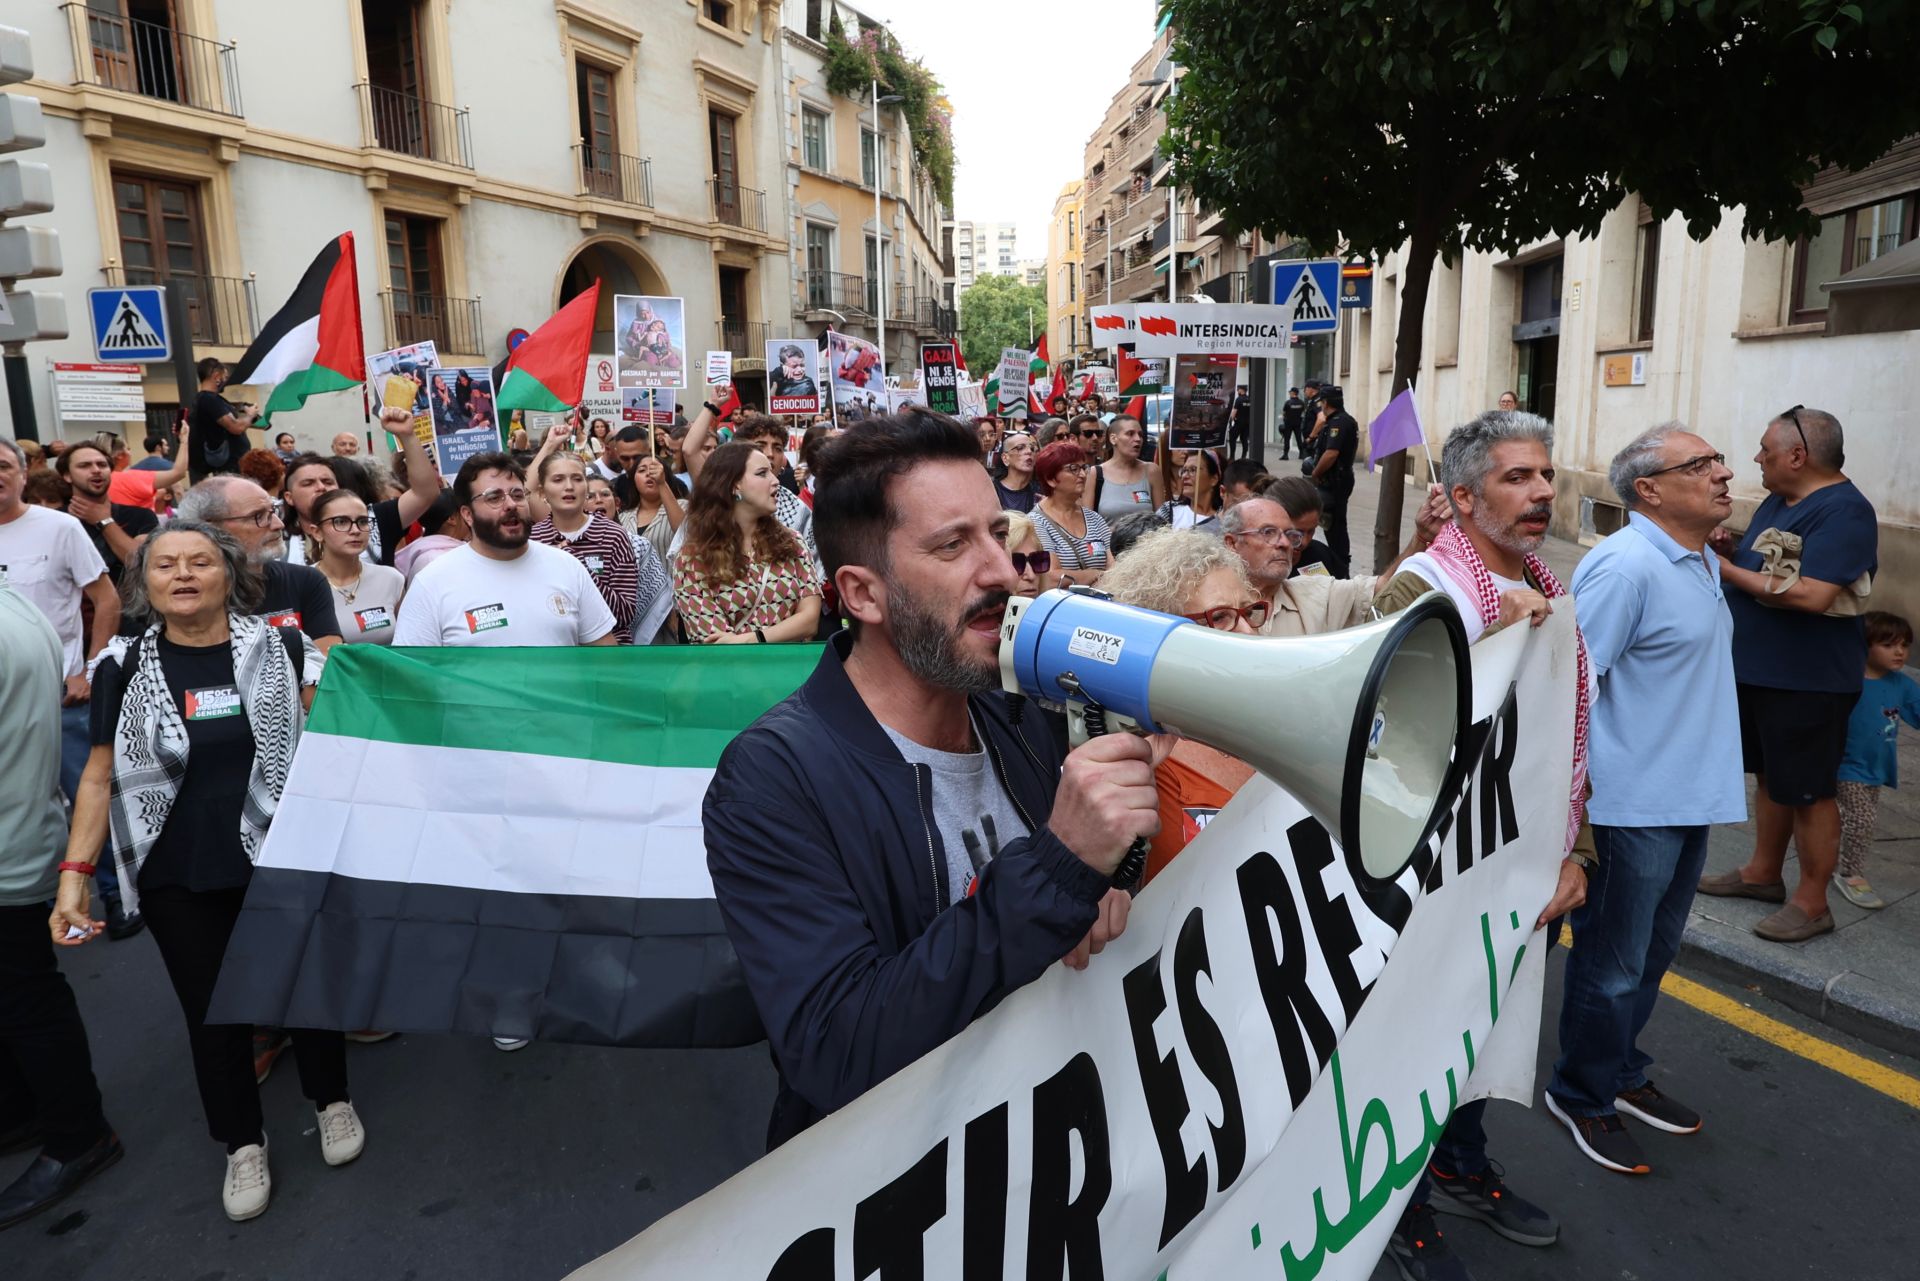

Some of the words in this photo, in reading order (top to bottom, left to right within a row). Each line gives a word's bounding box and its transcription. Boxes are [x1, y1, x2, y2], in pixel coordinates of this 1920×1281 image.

[1180, 324, 1284, 338] INTERSINDICA
[1197, 338, 1231, 351] Región
[924, 350, 953, 363] GAZA
[929, 366, 940, 377] NI
[943, 367, 953, 376] SE
[645, 378, 662, 386] GAZA
[927, 377, 956, 387] VENDE
[931, 391, 943, 401] NI
[945, 391, 956, 401] SE
[772, 398, 816, 411] GENOCIDIO
[442, 436, 465, 445] ISRAEL
[470, 433, 496, 442] ASESINO
[448, 445, 457, 453] de
[1077, 628, 1121, 647] VONYX
[195, 690, 214, 706] 15
[214, 688, 232, 697] OCT
[195, 708, 233, 718] GENERAL
[766, 1051, 1112, 1281] TIR
[1122, 907, 1247, 1254] ES
